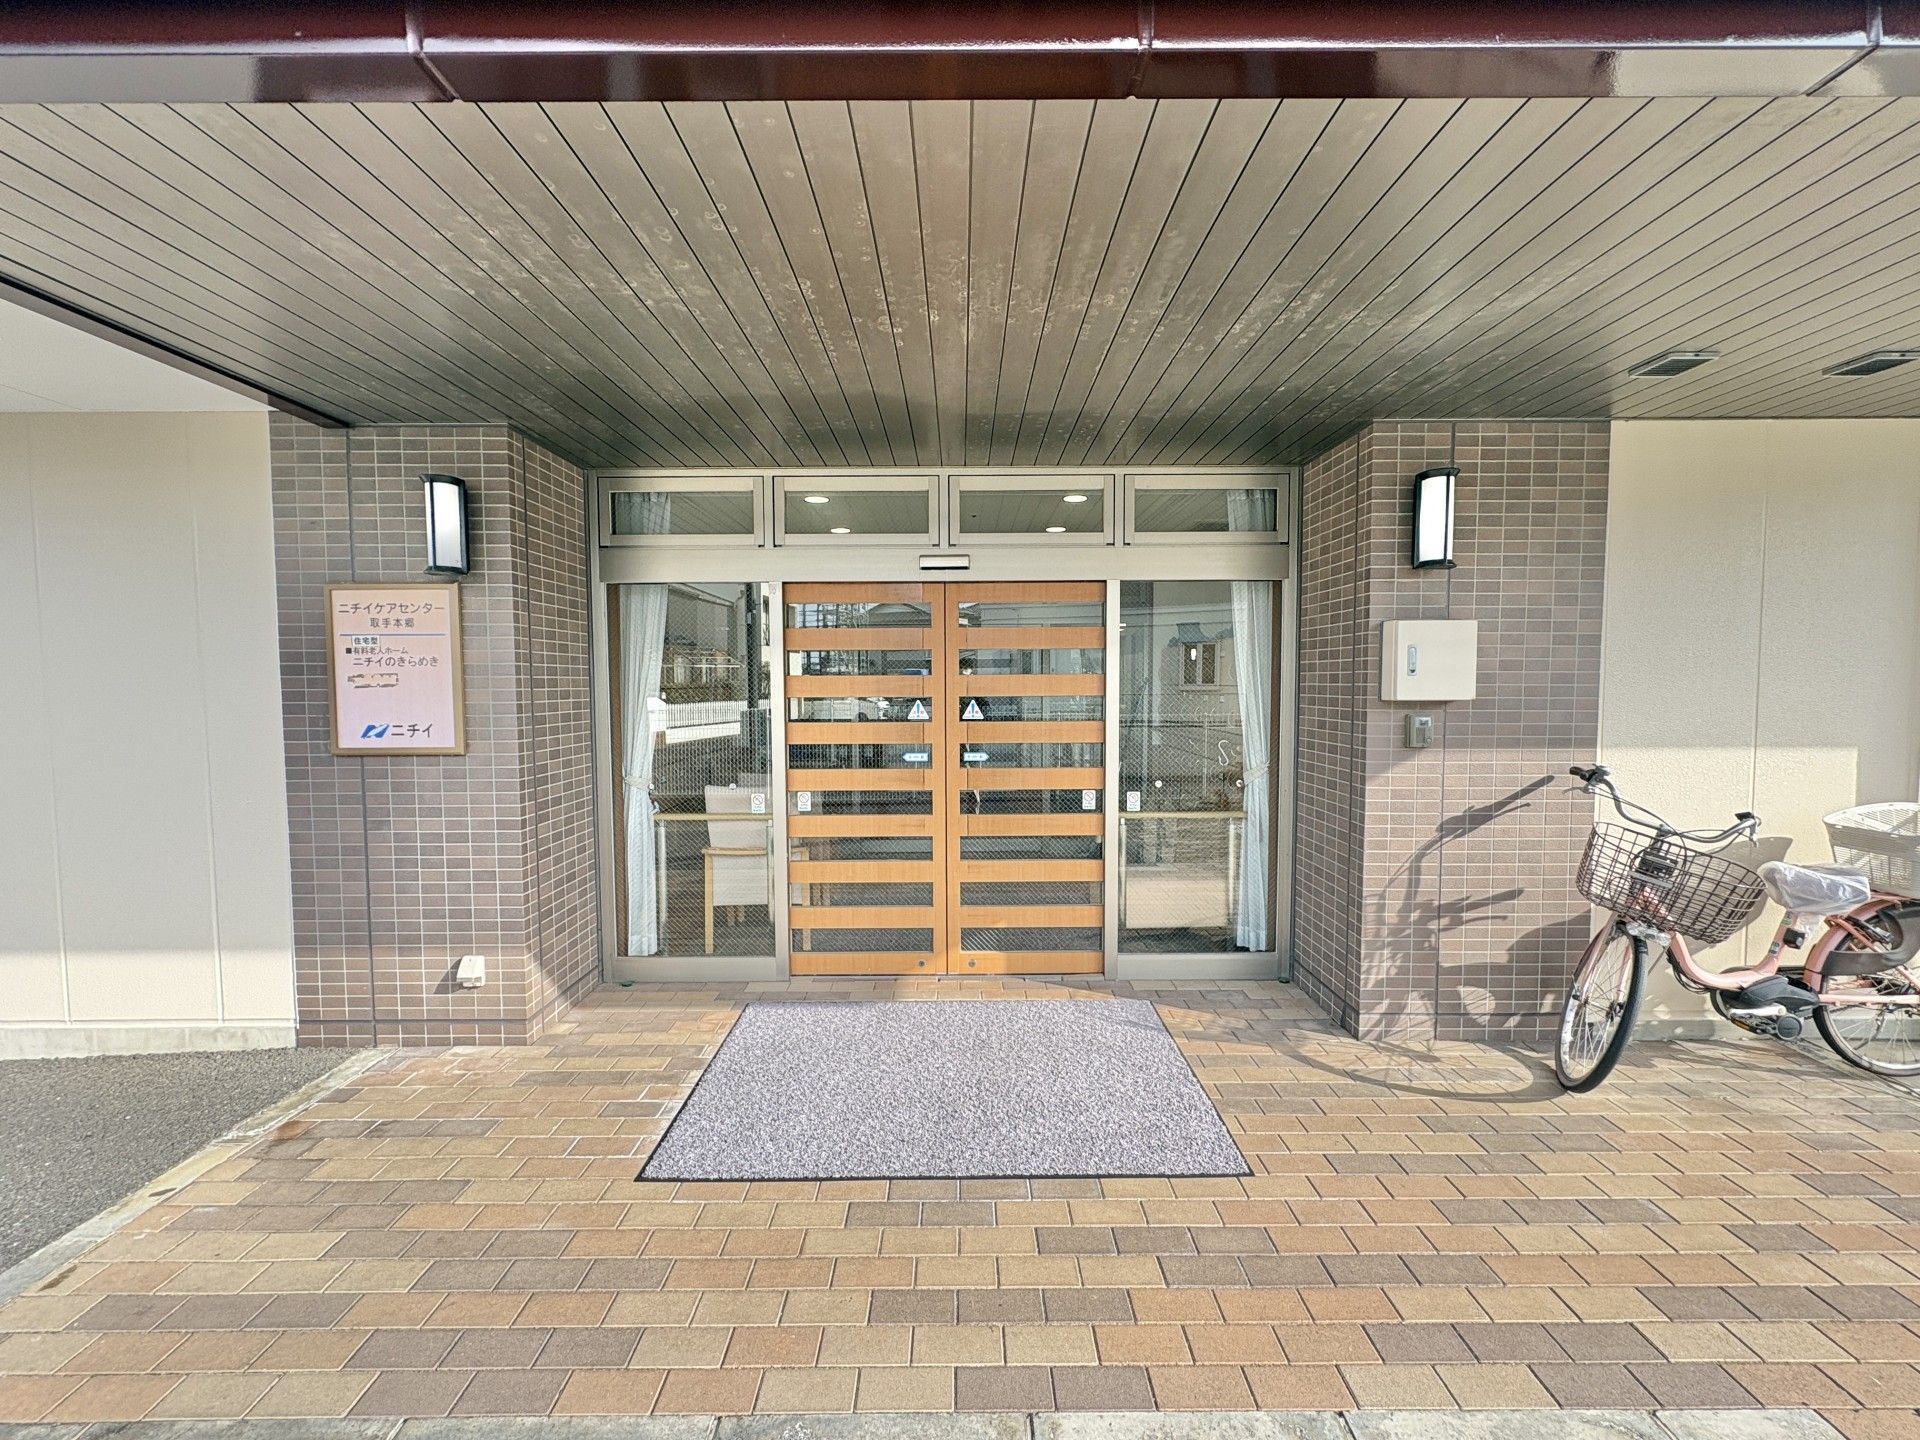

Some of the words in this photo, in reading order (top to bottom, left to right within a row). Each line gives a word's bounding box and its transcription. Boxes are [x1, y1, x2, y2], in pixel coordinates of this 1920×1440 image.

[338, 602, 445, 614] ニチイケアセンター
[370, 617, 415, 629] 取手本郷
[353, 637, 378, 645] 住宅型
[352, 655, 439, 667] ニチイのきらめき
[391, 723, 433, 738] ニチイ
